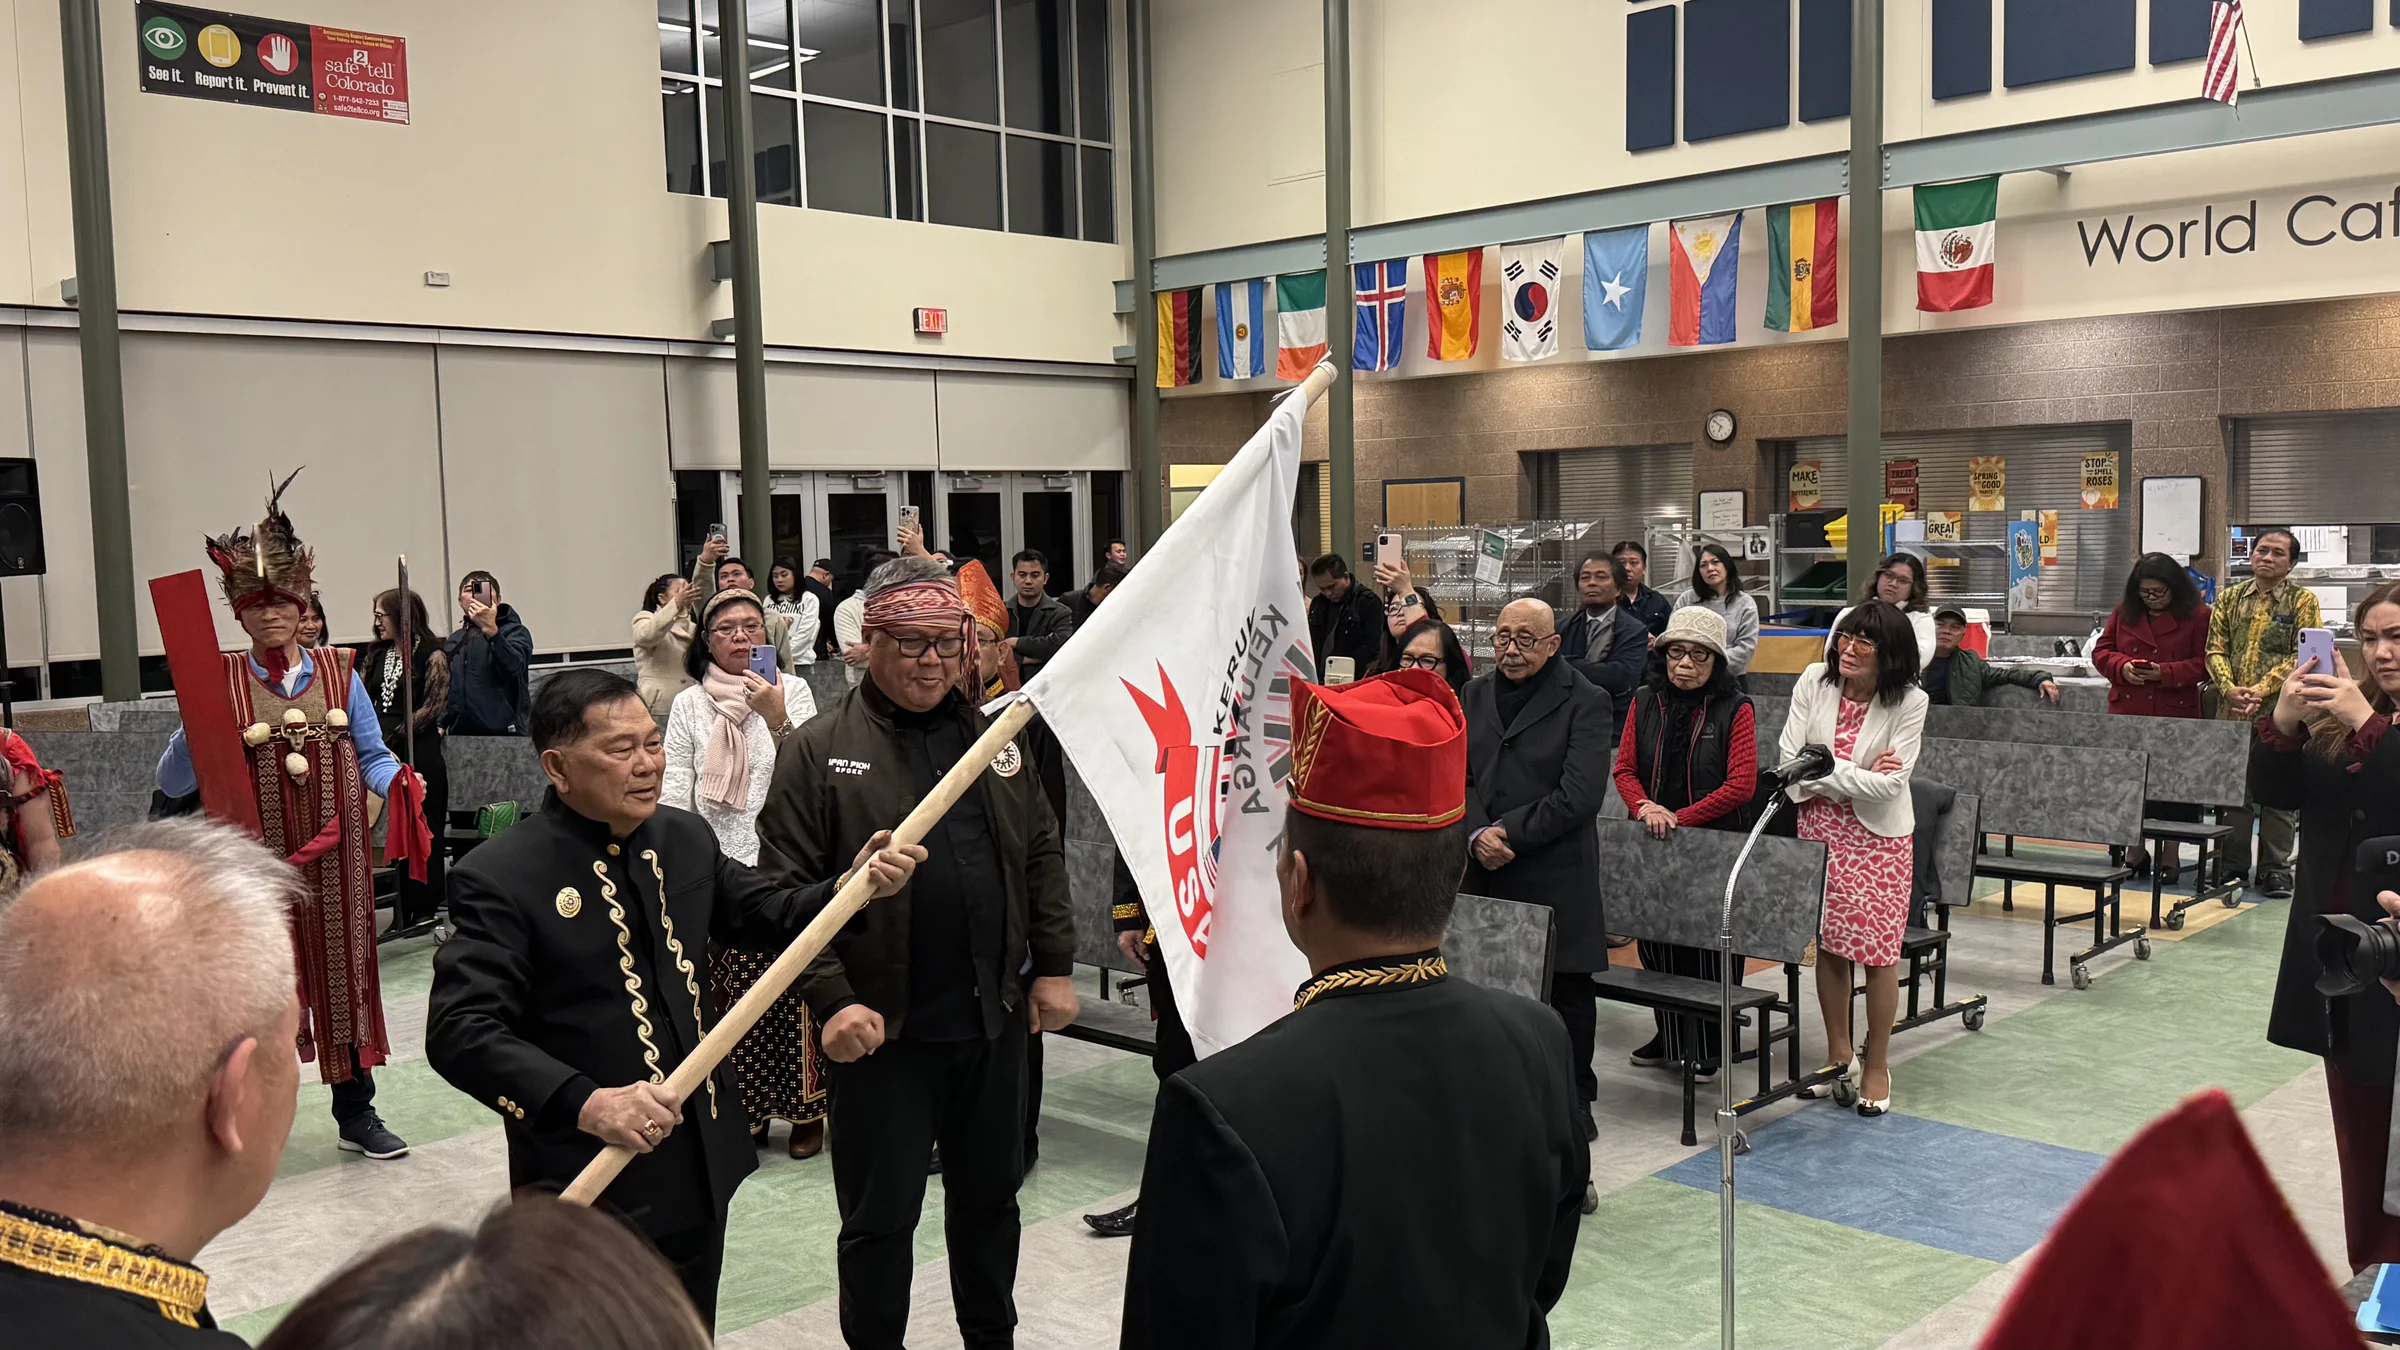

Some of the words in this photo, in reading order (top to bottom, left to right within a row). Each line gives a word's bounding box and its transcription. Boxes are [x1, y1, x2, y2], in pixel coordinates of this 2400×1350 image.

[149, 65, 169, 81] See
[172, 68, 184, 83] it.
[325, 57, 359, 75] safe
[356, 51, 365, 63] 2
[367, 62, 394, 80] tell
[195, 71, 233, 89] Report
[236, 76, 248, 91] it.
[253, 78, 296, 97] Prevent
[298, 84, 310, 98] it.
[326, 73, 395, 95] Colorado
[2077, 200, 2256, 268] World
[922, 310, 944, 330] EXIT
[2085, 458, 2106, 468] STOP
[1792, 470, 1818, 484] MAKE
[1973, 472, 1998, 480] SPRING
[1982, 480, 2001, 489] GOOD
[2086, 476, 2113, 486] ROSES
[1928, 520, 1961, 536] GREAT
